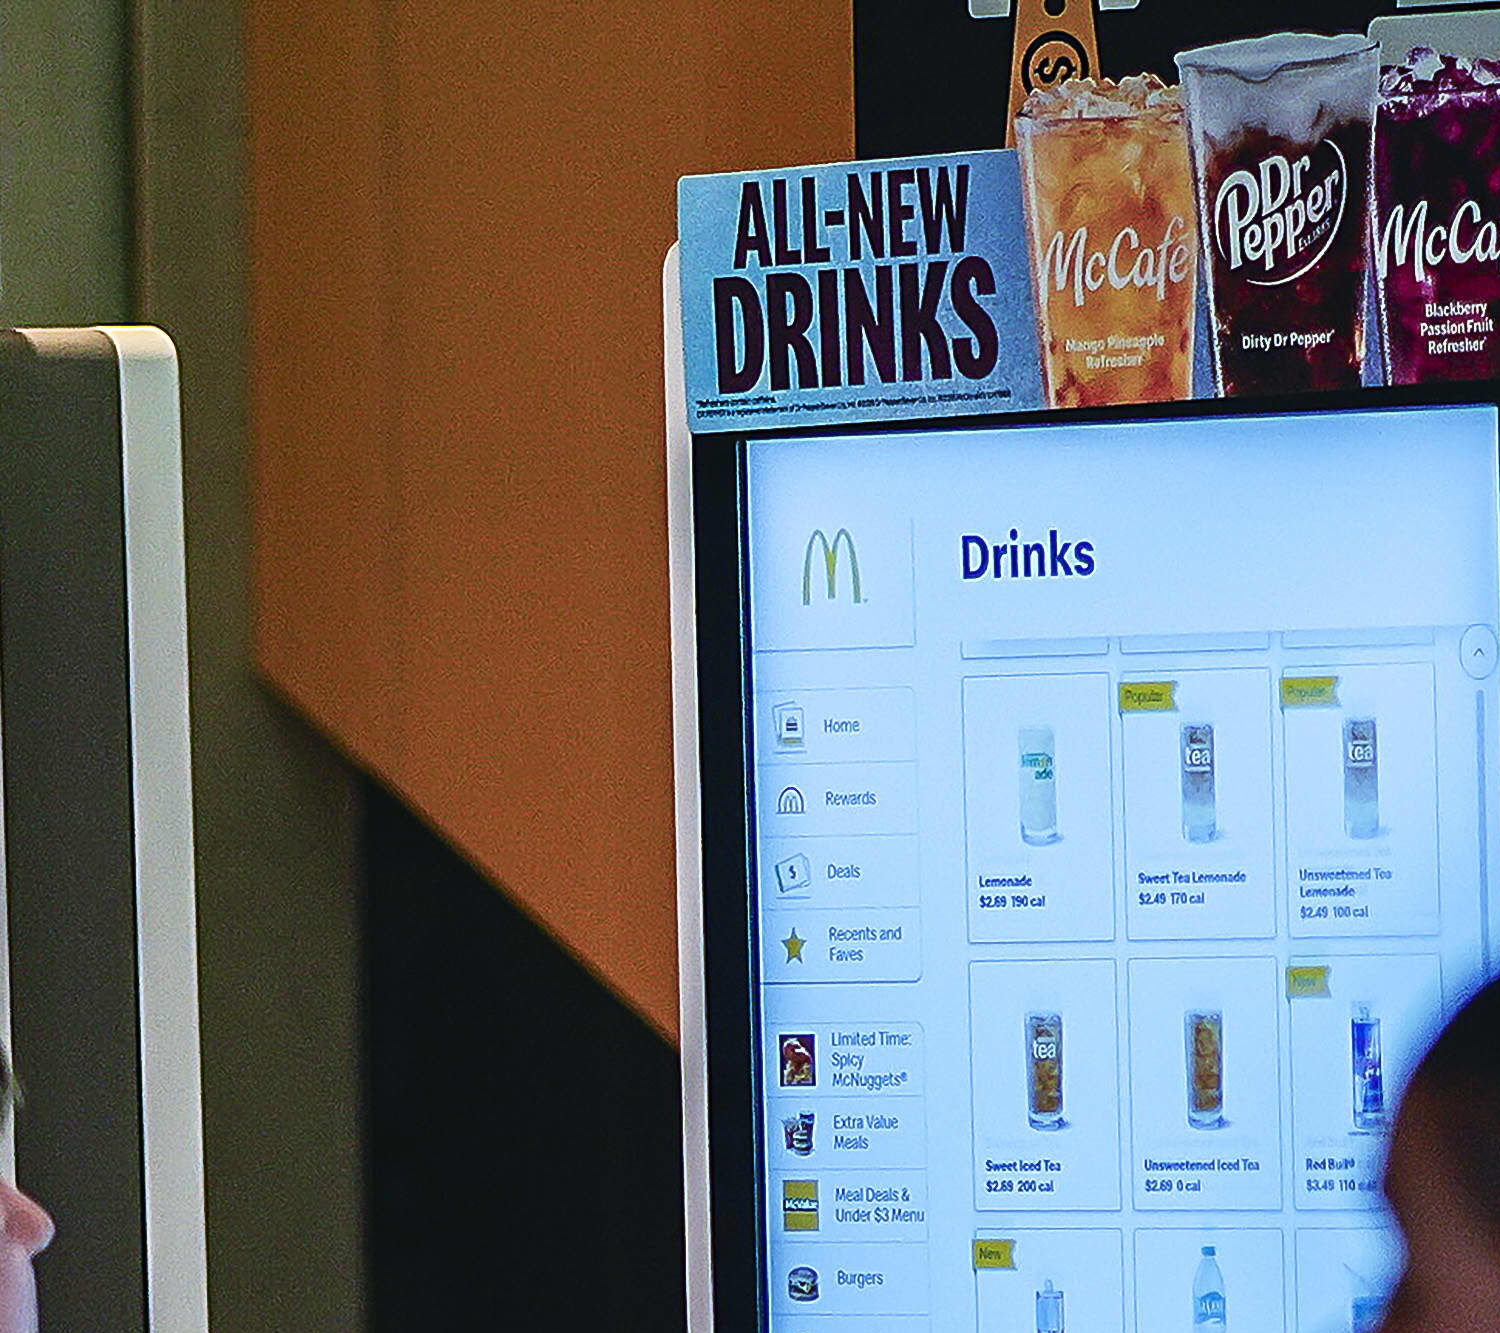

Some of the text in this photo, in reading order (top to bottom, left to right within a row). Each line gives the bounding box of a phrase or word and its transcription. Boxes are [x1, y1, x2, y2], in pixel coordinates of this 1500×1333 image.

[1259, 155, 1310, 216] Dr
[735, 166, 971, 271] ALL-NEW
[1215, 170, 1339, 271] Pepper
[1425, 301, 1487, 318] Blackberry
[712, 255, 998, 395] DRINKS
[1420, 317, 1494, 337] Passion Fruit
[1242, 334, 1271, 351] Dirty
[1273, 333, 1288, 347] Dr
[961, 528, 1095, 579] Drinks
[823, 718, 860, 733] Home
[825, 791, 876, 806] Rewards
[827, 864, 861, 879] Deals
[1138, 871, 1246, 885] Sweet Tea Lemonade
[1300, 868, 1392, 882] Unsweetened Tea
[978, 875, 1032, 888] Lemonade
[1138, 892, 1205, 906] $2.49 170 cal
[1300, 886, 1355, 898] Lemonade
[1029, 895, 1045, 908] cal
[1353, 905, 1369, 918] cal
[829, 927, 902, 941] Recents and
[829, 947, 863, 961] Faves
[831, 1032, 876, 1046] Limited
[1033, 1039, 1056, 1059] tea
[832, 1052, 864, 1069] Spicy
[833, 1115, 898, 1129] Extra Value
[834, 1136, 869, 1150] Meals
[985, 1159, 1061, 1172] Sweet Iced Tea
[1144, 1159, 1260, 1172] Unsweetened Iced Tea
[1306, 1158, 1327, 1171] Red
[1017, 1180, 1037, 1193] 200
[1038, 1180, 1055, 1193] cal
[1185, 1180, 1201, 1192] cal
[836, 1188, 910, 1202] Meal Deals &
[836, 1207, 925, 1224] Under $3 Menu
[979, 1247, 1001, 1260] New
[837, 1270, 884, 1289] Burgers
